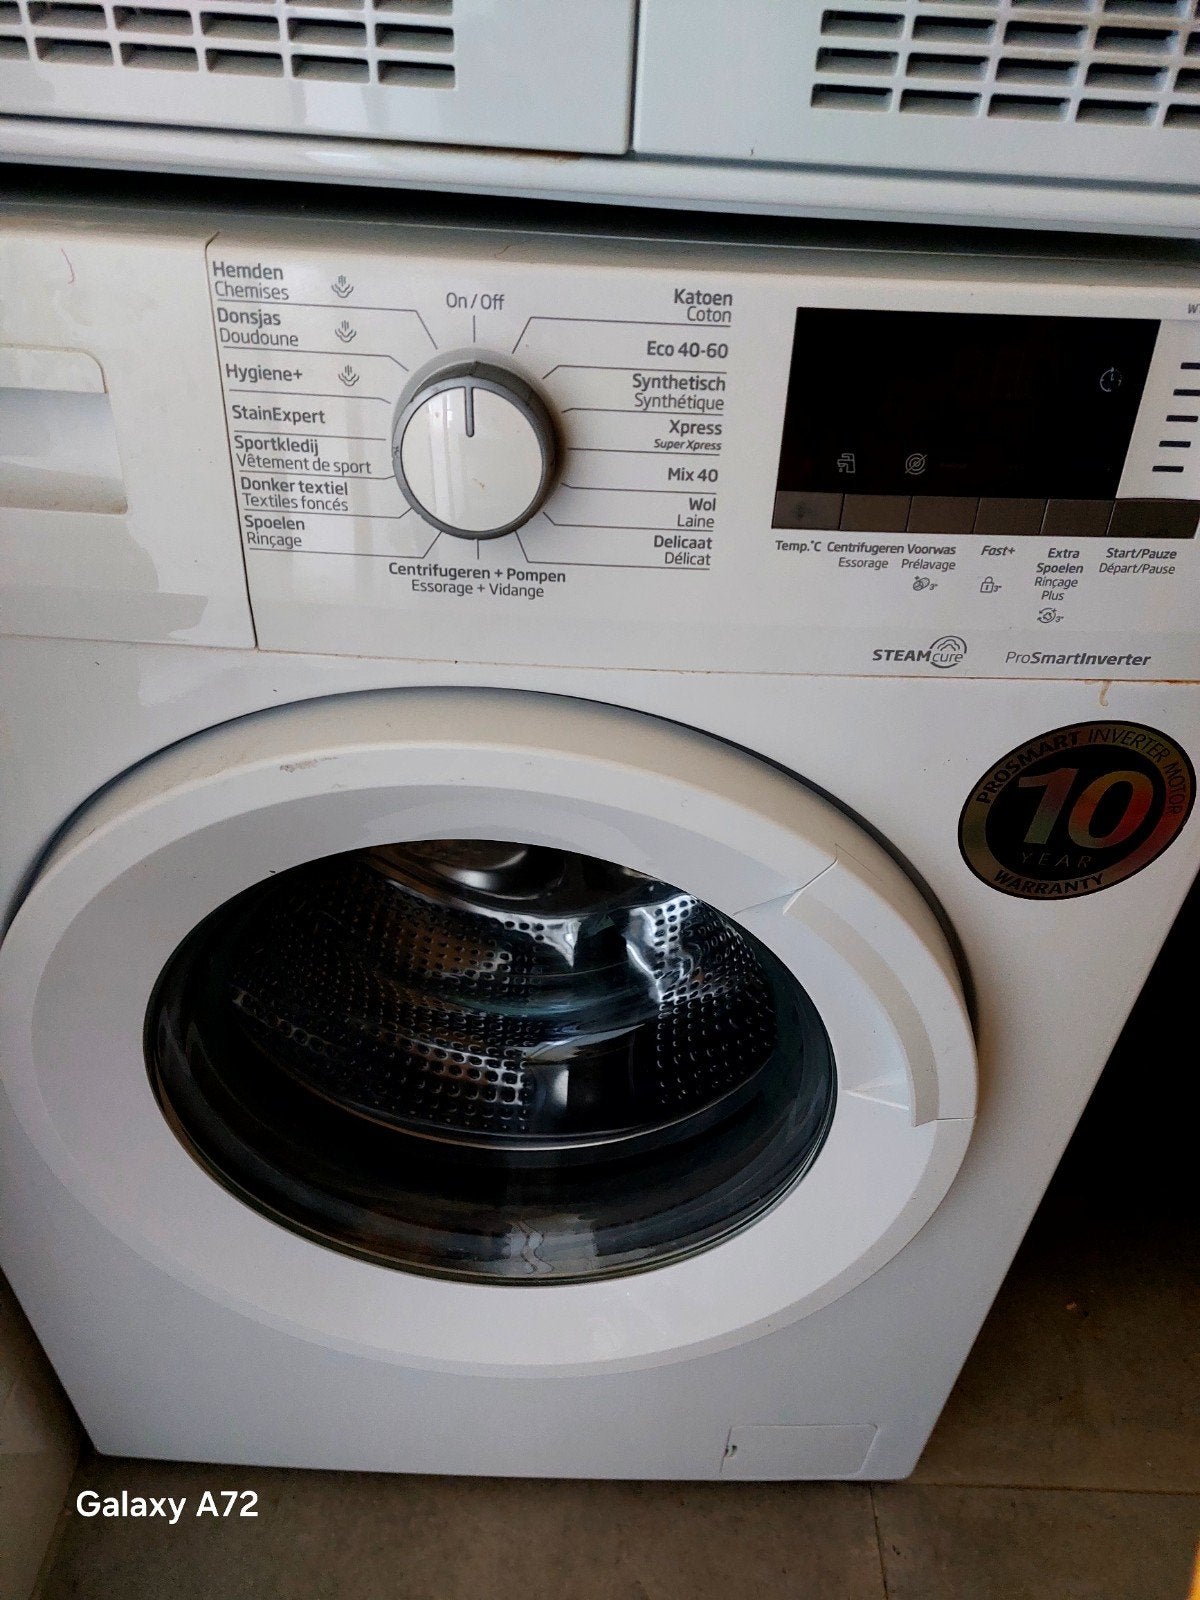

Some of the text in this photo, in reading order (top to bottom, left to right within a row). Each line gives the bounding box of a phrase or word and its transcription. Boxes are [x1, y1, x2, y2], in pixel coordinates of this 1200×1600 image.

[212, 261, 284, 280] Hemden
[214, 281, 289, 300] Chemises
[673, 288, 733, 306] Katoen
[217, 307, 281, 329] Donsjas
[687, 305, 732, 323] Coton
[220, 327, 299, 347] Doudoune
[646, 340, 729, 359] Eco 40-60
[225, 363, 303, 383] Hygiene+
[632, 372, 726, 392] Synthetisch
[634, 392, 725, 413] Synthétique
[232, 404, 326, 425] StainExpert
[668, 419, 722, 437] Xpress
[234, 435, 319, 457] Sportkledij
[653, 438, 722, 451] Super Xpress
[235, 453, 372, 476] Vêtement de sport
[667, 467, 719, 483] Mix 40
[240, 476, 349, 496] Donker textiel
[242, 492, 349, 512] Textiles foncés
[689, 497, 716, 512] Wol
[244, 515, 305, 533] Spoelen
[677, 513, 715, 528] Laine
[246, 532, 303, 550] Rinçage
[653, 534, 713, 550] Delicaat
[826, 541, 905, 556] Centrifugeren
[907, 543, 957, 555] Voorwas
[664, 551, 712, 566] Délicat
[1047, 547, 1080, 560] Extra
[1105, 547, 1178, 560] Start/Pauze
[388, 562, 567, 584] Centrifugeren + Pompen
[838, 557, 889, 571] Essorage
[901, 558, 956, 572] Prélavage
[1035, 562, 1084, 576] Spoelen
[1098, 562, 1176, 576] Départ/Pause
[411, 579, 545, 601] Essorage + Vidange
[1034, 576, 1079, 589] Rinçage
[1041, 590, 1065, 601] Plus
[1005, 651, 1151, 666] ProSmartInverter
[976, 727, 1187, 816] PROSMART INVERTER MOTOR
[1018, 767, 1154, 849] 10
[1021, 852, 1093, 868] YEAR
[993, 869, 1104, 895] WARRANTY
